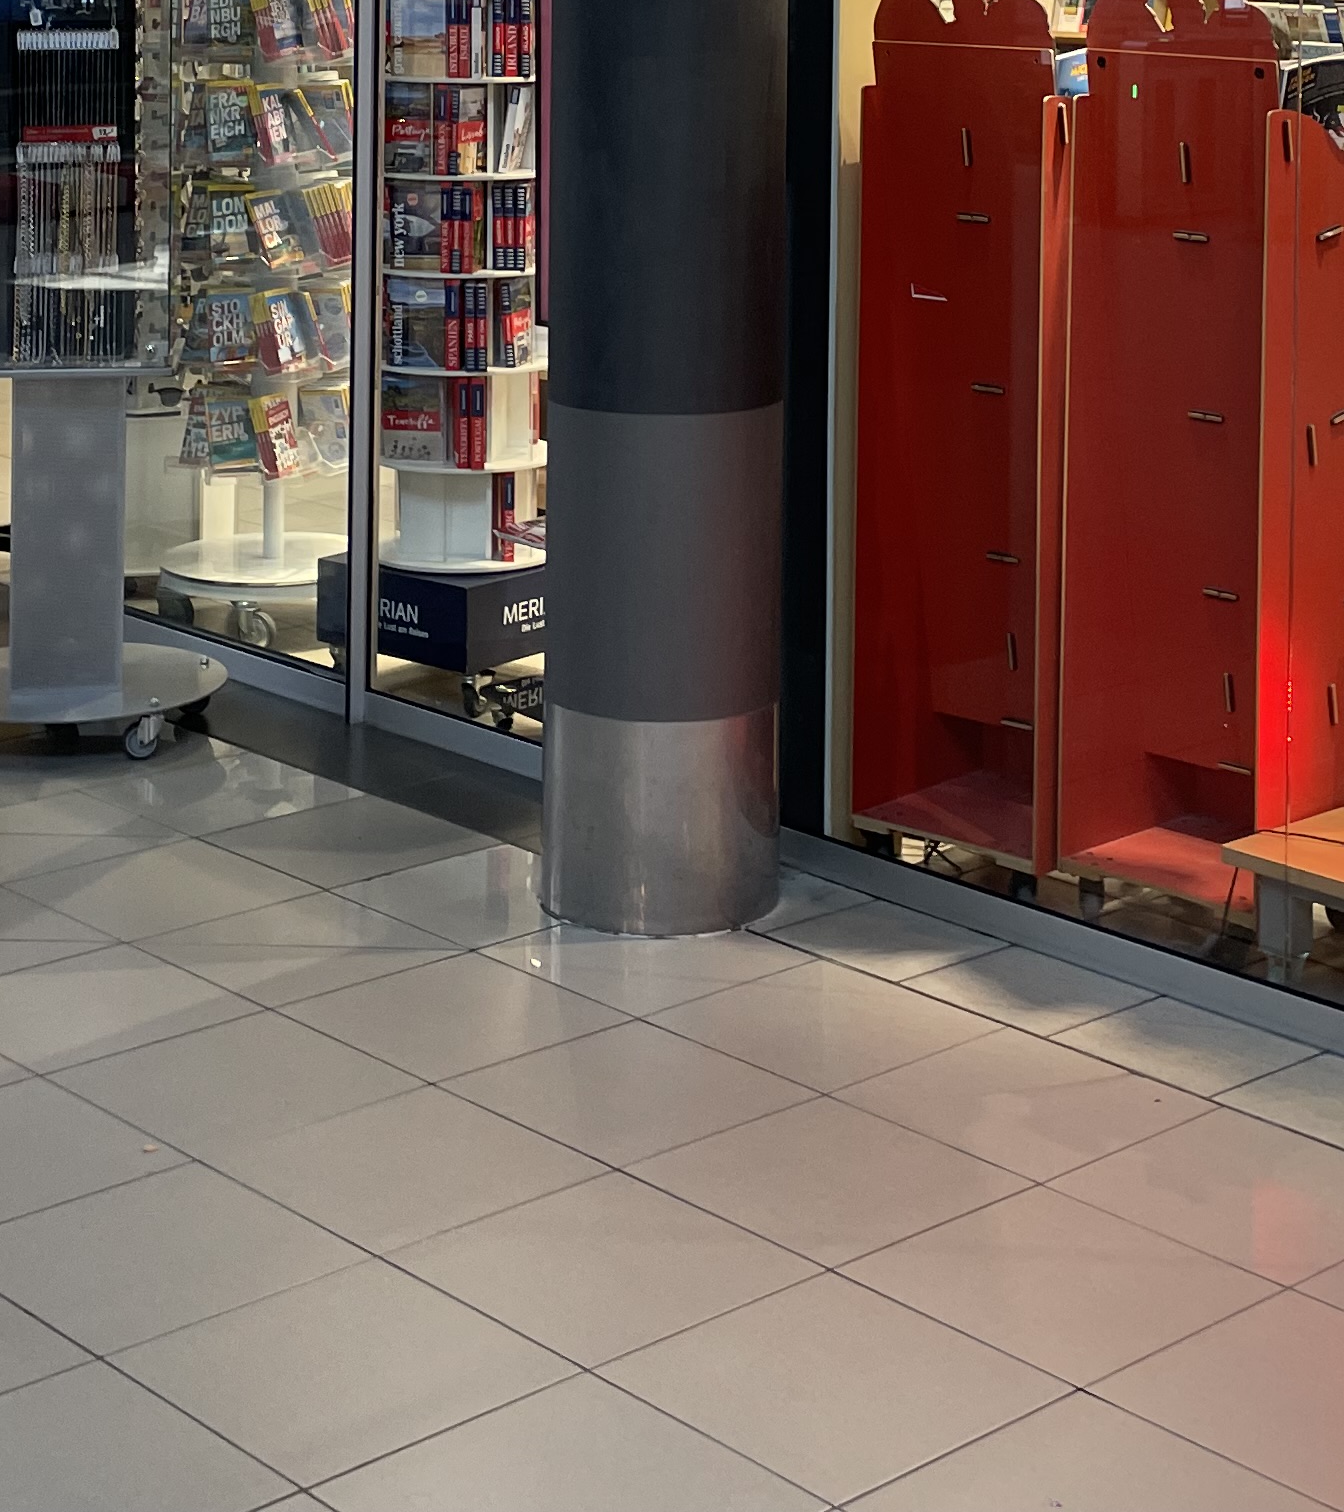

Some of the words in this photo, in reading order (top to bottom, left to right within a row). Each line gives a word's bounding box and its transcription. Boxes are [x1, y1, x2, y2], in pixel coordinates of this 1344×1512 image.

[210, 7, 241, 24] NBU
[210, 23, 241, 39] RGH
[507, 25, 518, 71] IRLAND
[210, 90, 239, 109] FRA
[210, 106, 241, 125] NKR
[210, 120, 246, 140] EICH
[212, 196, 246, 216] LON
[254, 199, 281, 220] MAL
[213, 214, 249, 233] DON
[392, 203, 407, 236] york
[264, 231, 284, 249] CA
[394, 240, 405, 268] new
[212, 299, 241, 317] STO
[212, 313, 244, 332] CKH
[213, 330, 245, 348] OLM
[392, 304, 403, 365] schottland
[448, 319, 458, 367] SPANIEN
[211, 406, 244, 425] ZYP
[213, 423, 246, 442] ERN
[503, 596, 545, 625] MERI
